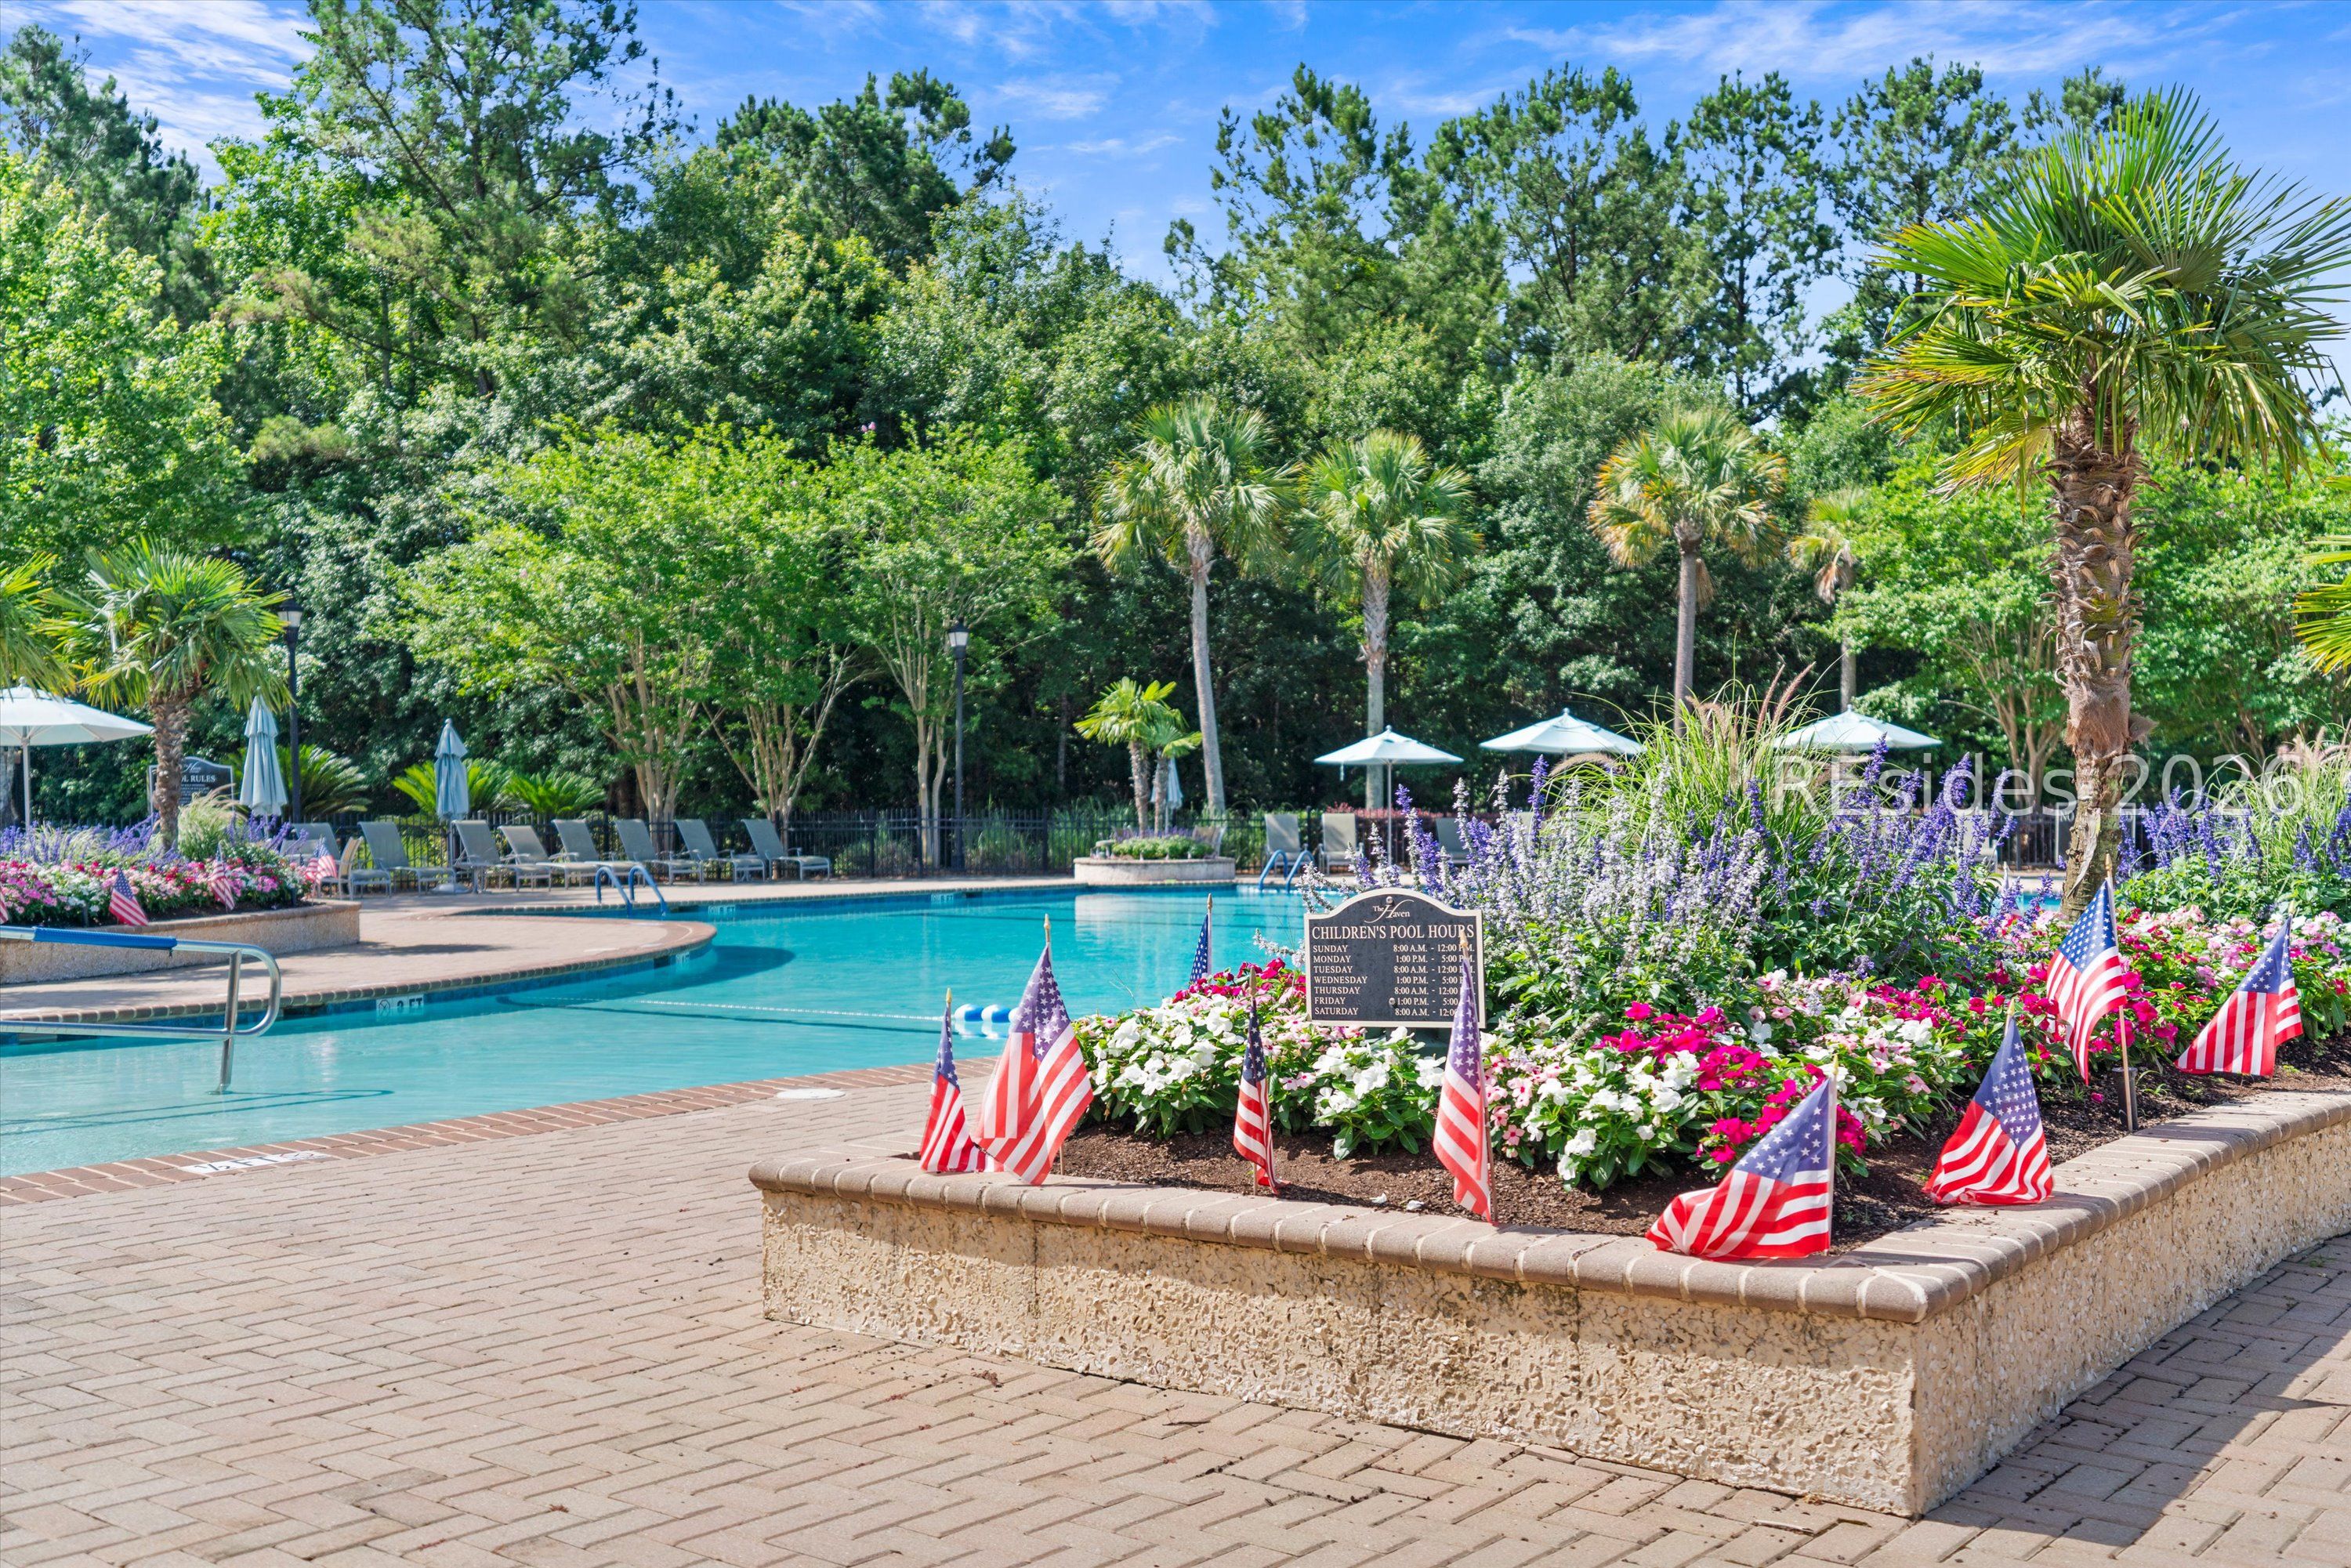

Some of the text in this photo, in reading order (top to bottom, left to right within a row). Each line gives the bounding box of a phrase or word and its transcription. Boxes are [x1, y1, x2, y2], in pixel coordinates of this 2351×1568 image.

[1312, 924, 1474, 940] CHILDREN'S POOL HOURS
[230, 1156, 278, 1167] FT
